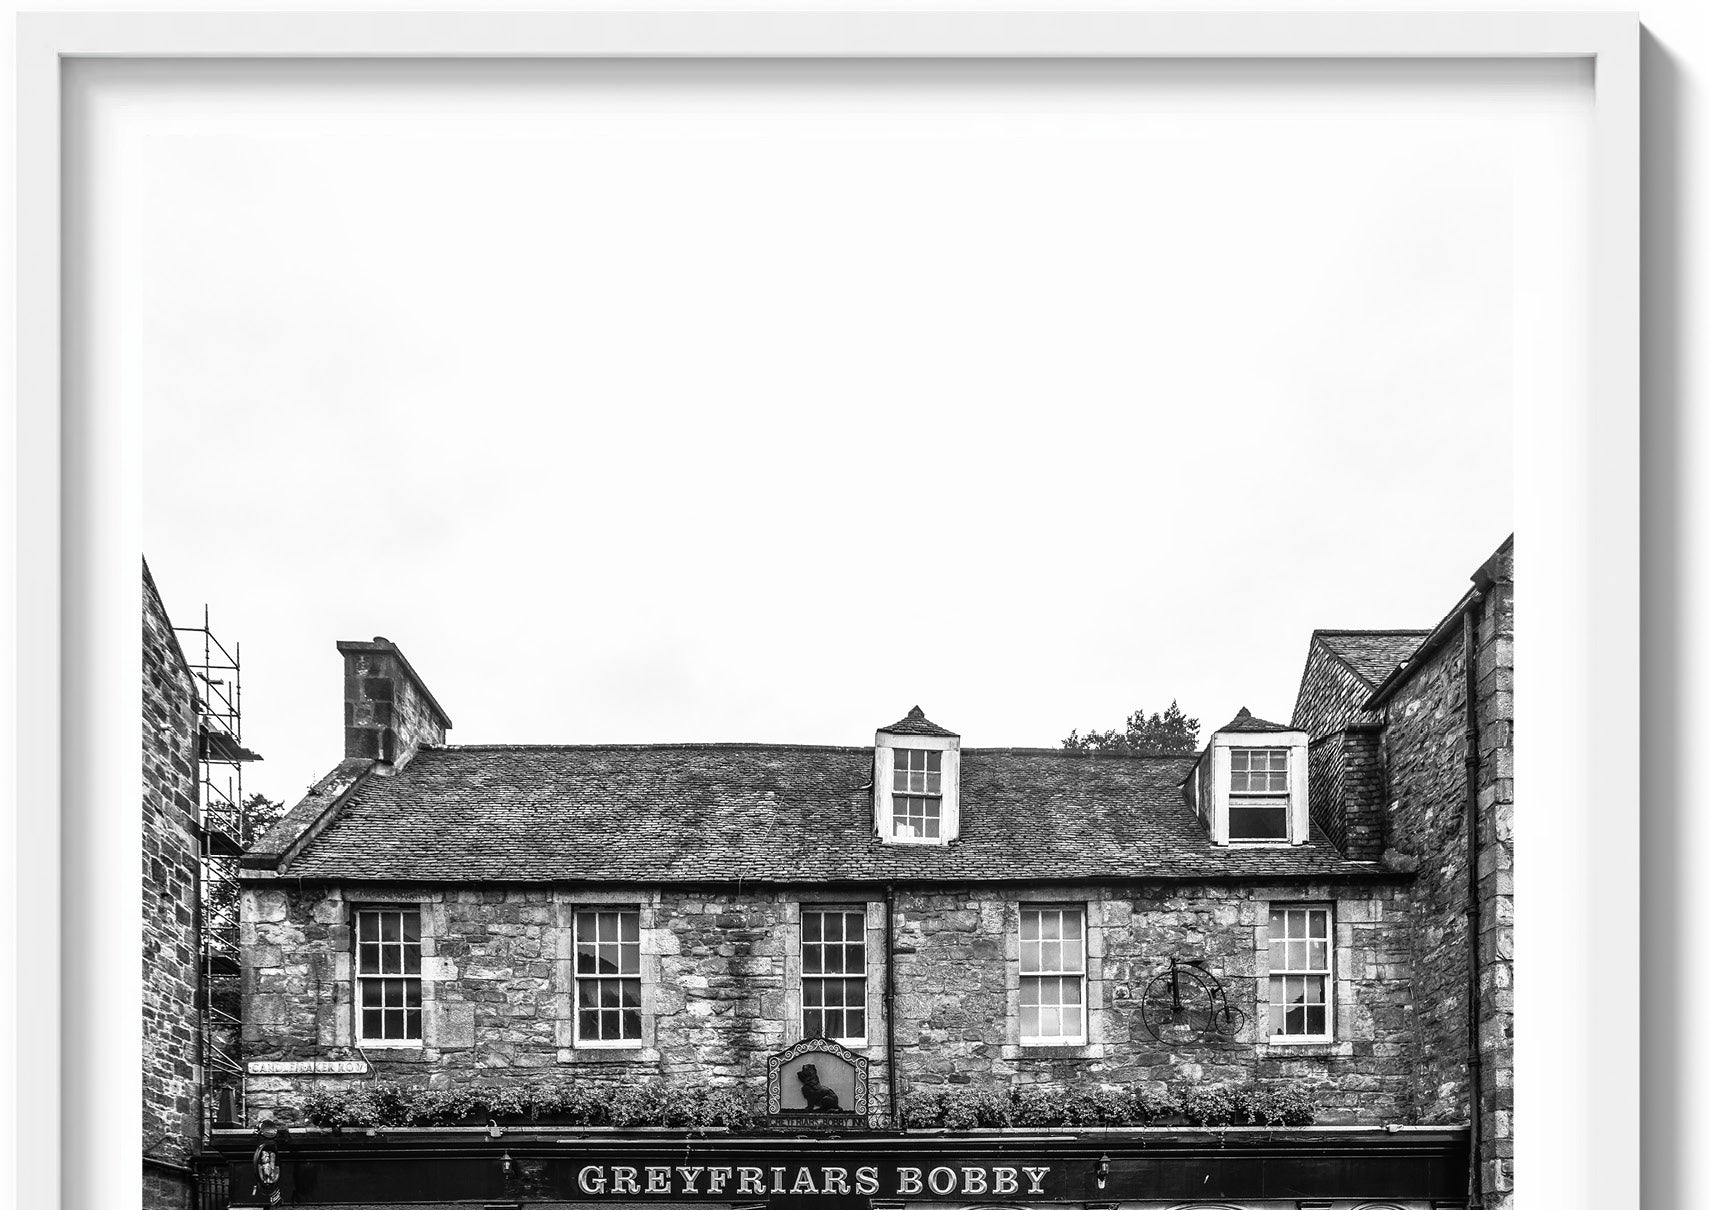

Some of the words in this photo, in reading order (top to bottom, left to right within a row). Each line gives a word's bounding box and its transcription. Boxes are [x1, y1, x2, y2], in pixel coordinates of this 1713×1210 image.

[251, 1063, 334, 1073] CANDLEMAKER
[338, 1062, 363, 1073] ROW
[577, 1165, 880, 1195] GREYFRIARS
[896, 1165, 1050, 1195] BOBBY
